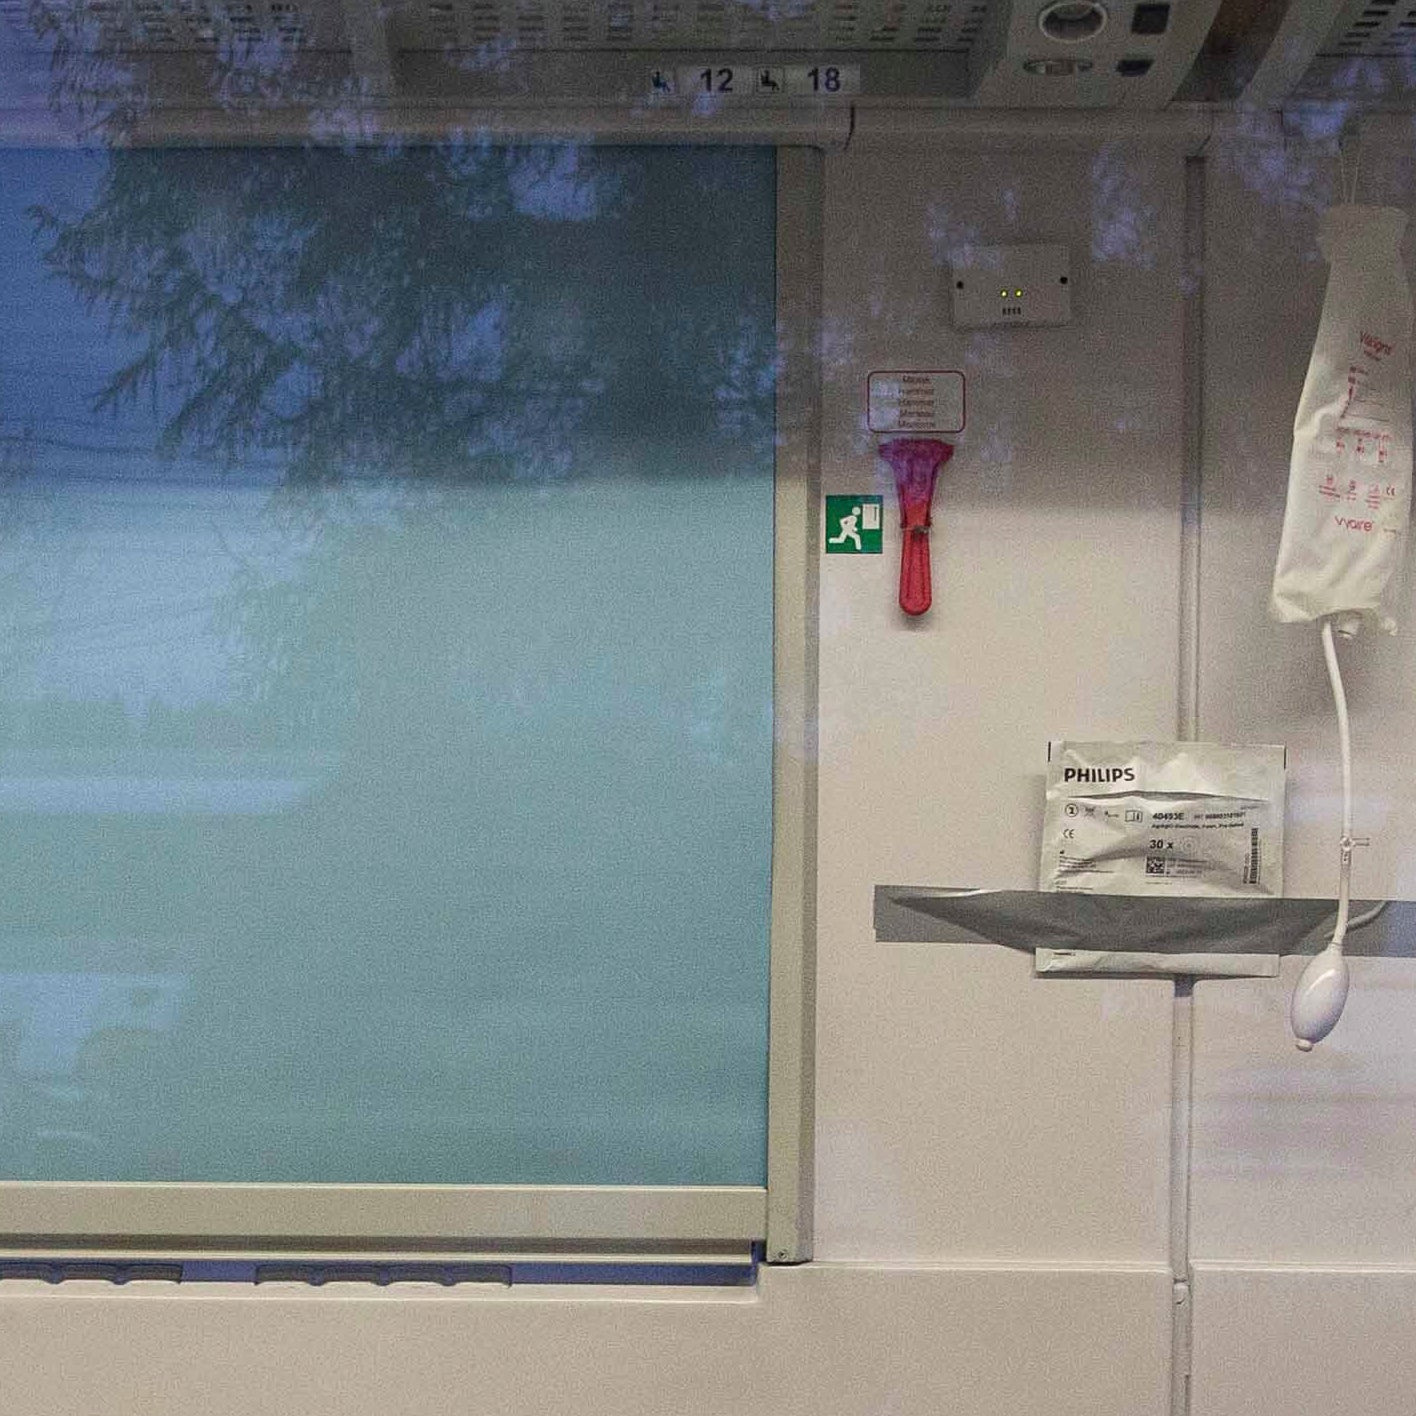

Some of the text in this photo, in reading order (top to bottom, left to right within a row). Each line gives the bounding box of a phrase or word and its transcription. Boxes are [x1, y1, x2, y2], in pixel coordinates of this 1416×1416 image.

[699, 67, 842, 93] 12 18
[1063, 767, 1136, 783] PHILIPS
[1149, 838, 1174, 849] 30 x
